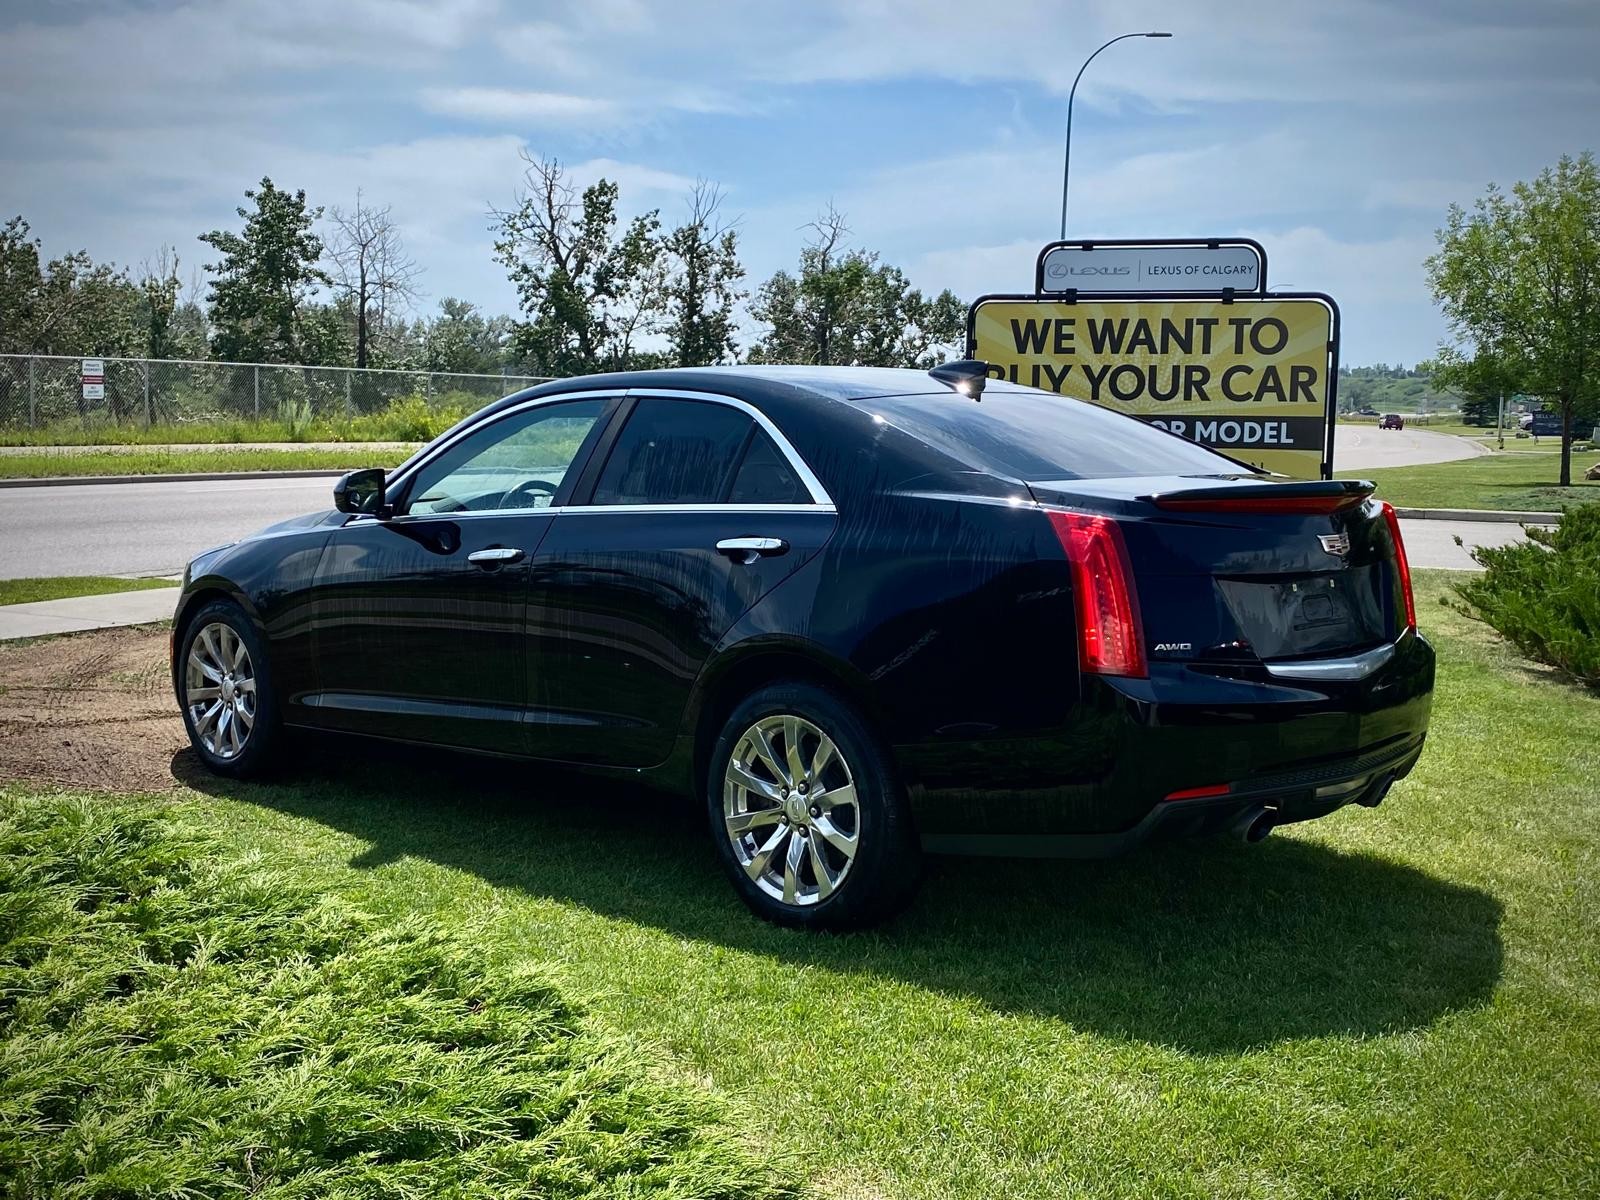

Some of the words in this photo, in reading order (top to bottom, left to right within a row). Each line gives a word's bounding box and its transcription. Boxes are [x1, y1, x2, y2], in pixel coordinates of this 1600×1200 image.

[1070, 266, 1131, 276] LEXUS
[1147, 265, 1182, 275] LEXUS
[1184, 265, 1200, 275] OF
[1202, 264, 1255, 276] CALGARY
[1010, 318, 1075, 354] WE
[1086, 317, 1219, 355] WANT
[1228, 317, 1289, 355] TO
[1081, 363, 1212, 402] YOUR
[1220, 363, 1318, 403] CAR
[1195, 421, 1295, 444] MODEL
[1154, 643, 1192, 651] AWD
